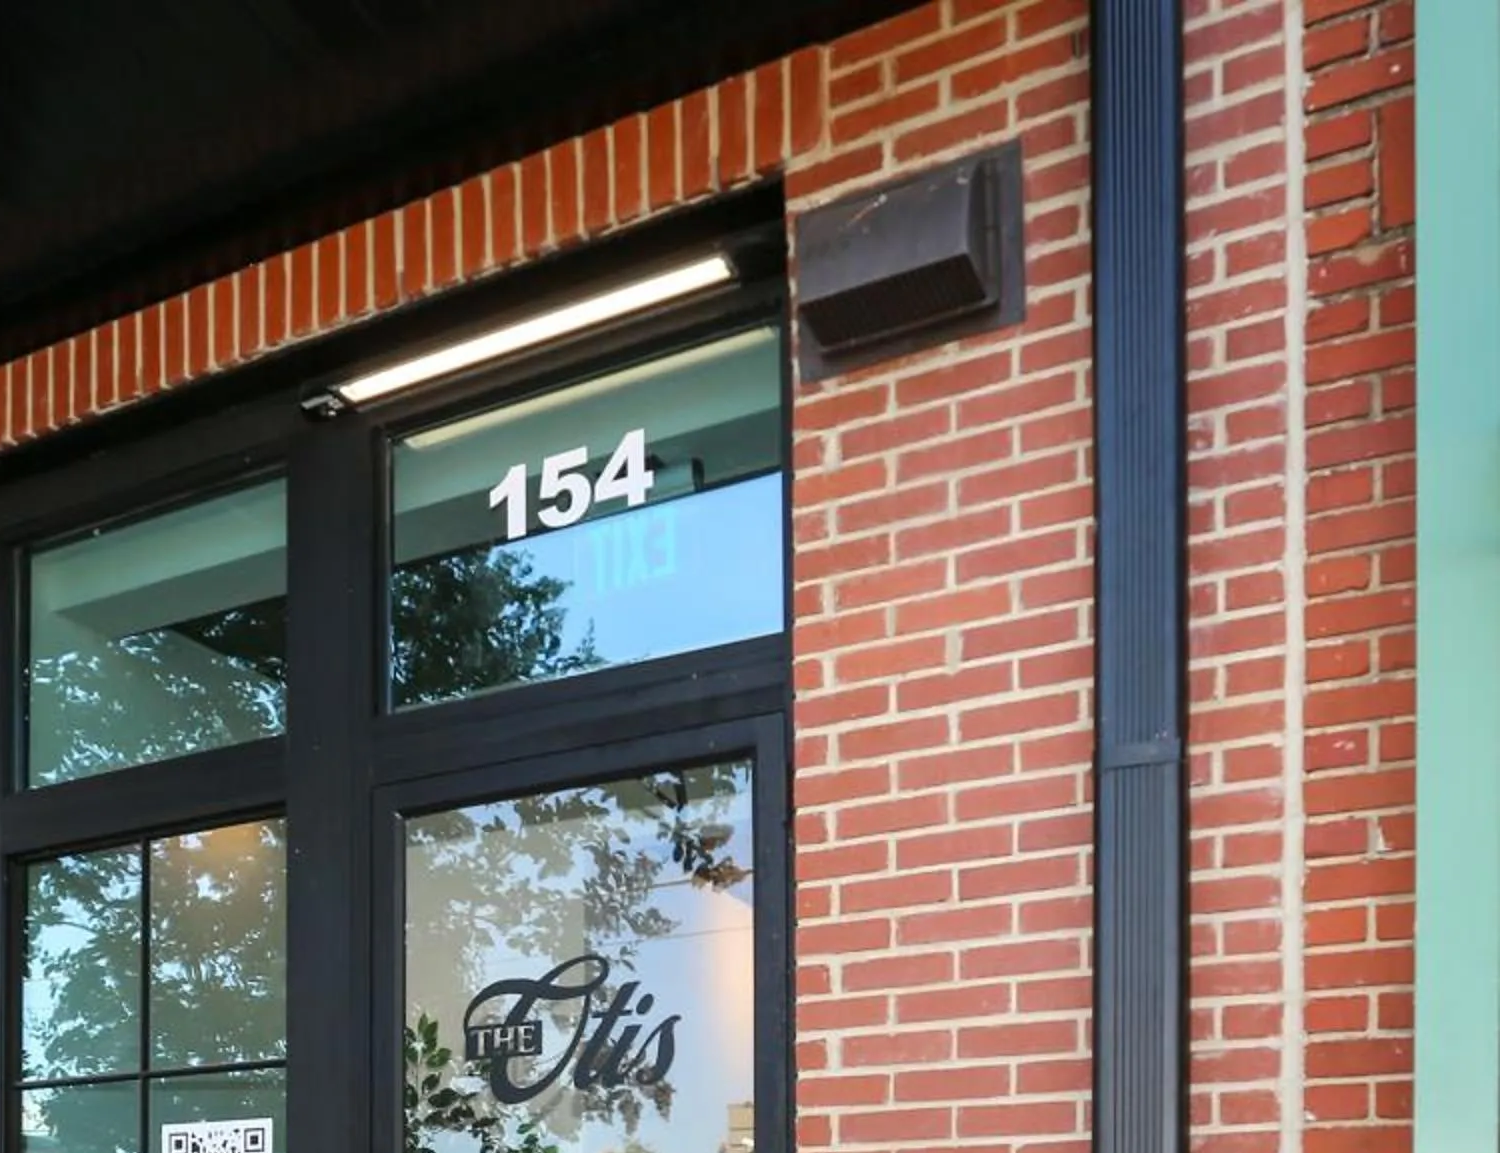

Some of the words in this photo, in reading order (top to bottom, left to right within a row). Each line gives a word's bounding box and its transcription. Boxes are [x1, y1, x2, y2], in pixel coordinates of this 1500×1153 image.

[488, 428, 654, 540] 154
[463, 954, 682, 1104] Otis
[471, 1025, 536, 1056] THE
